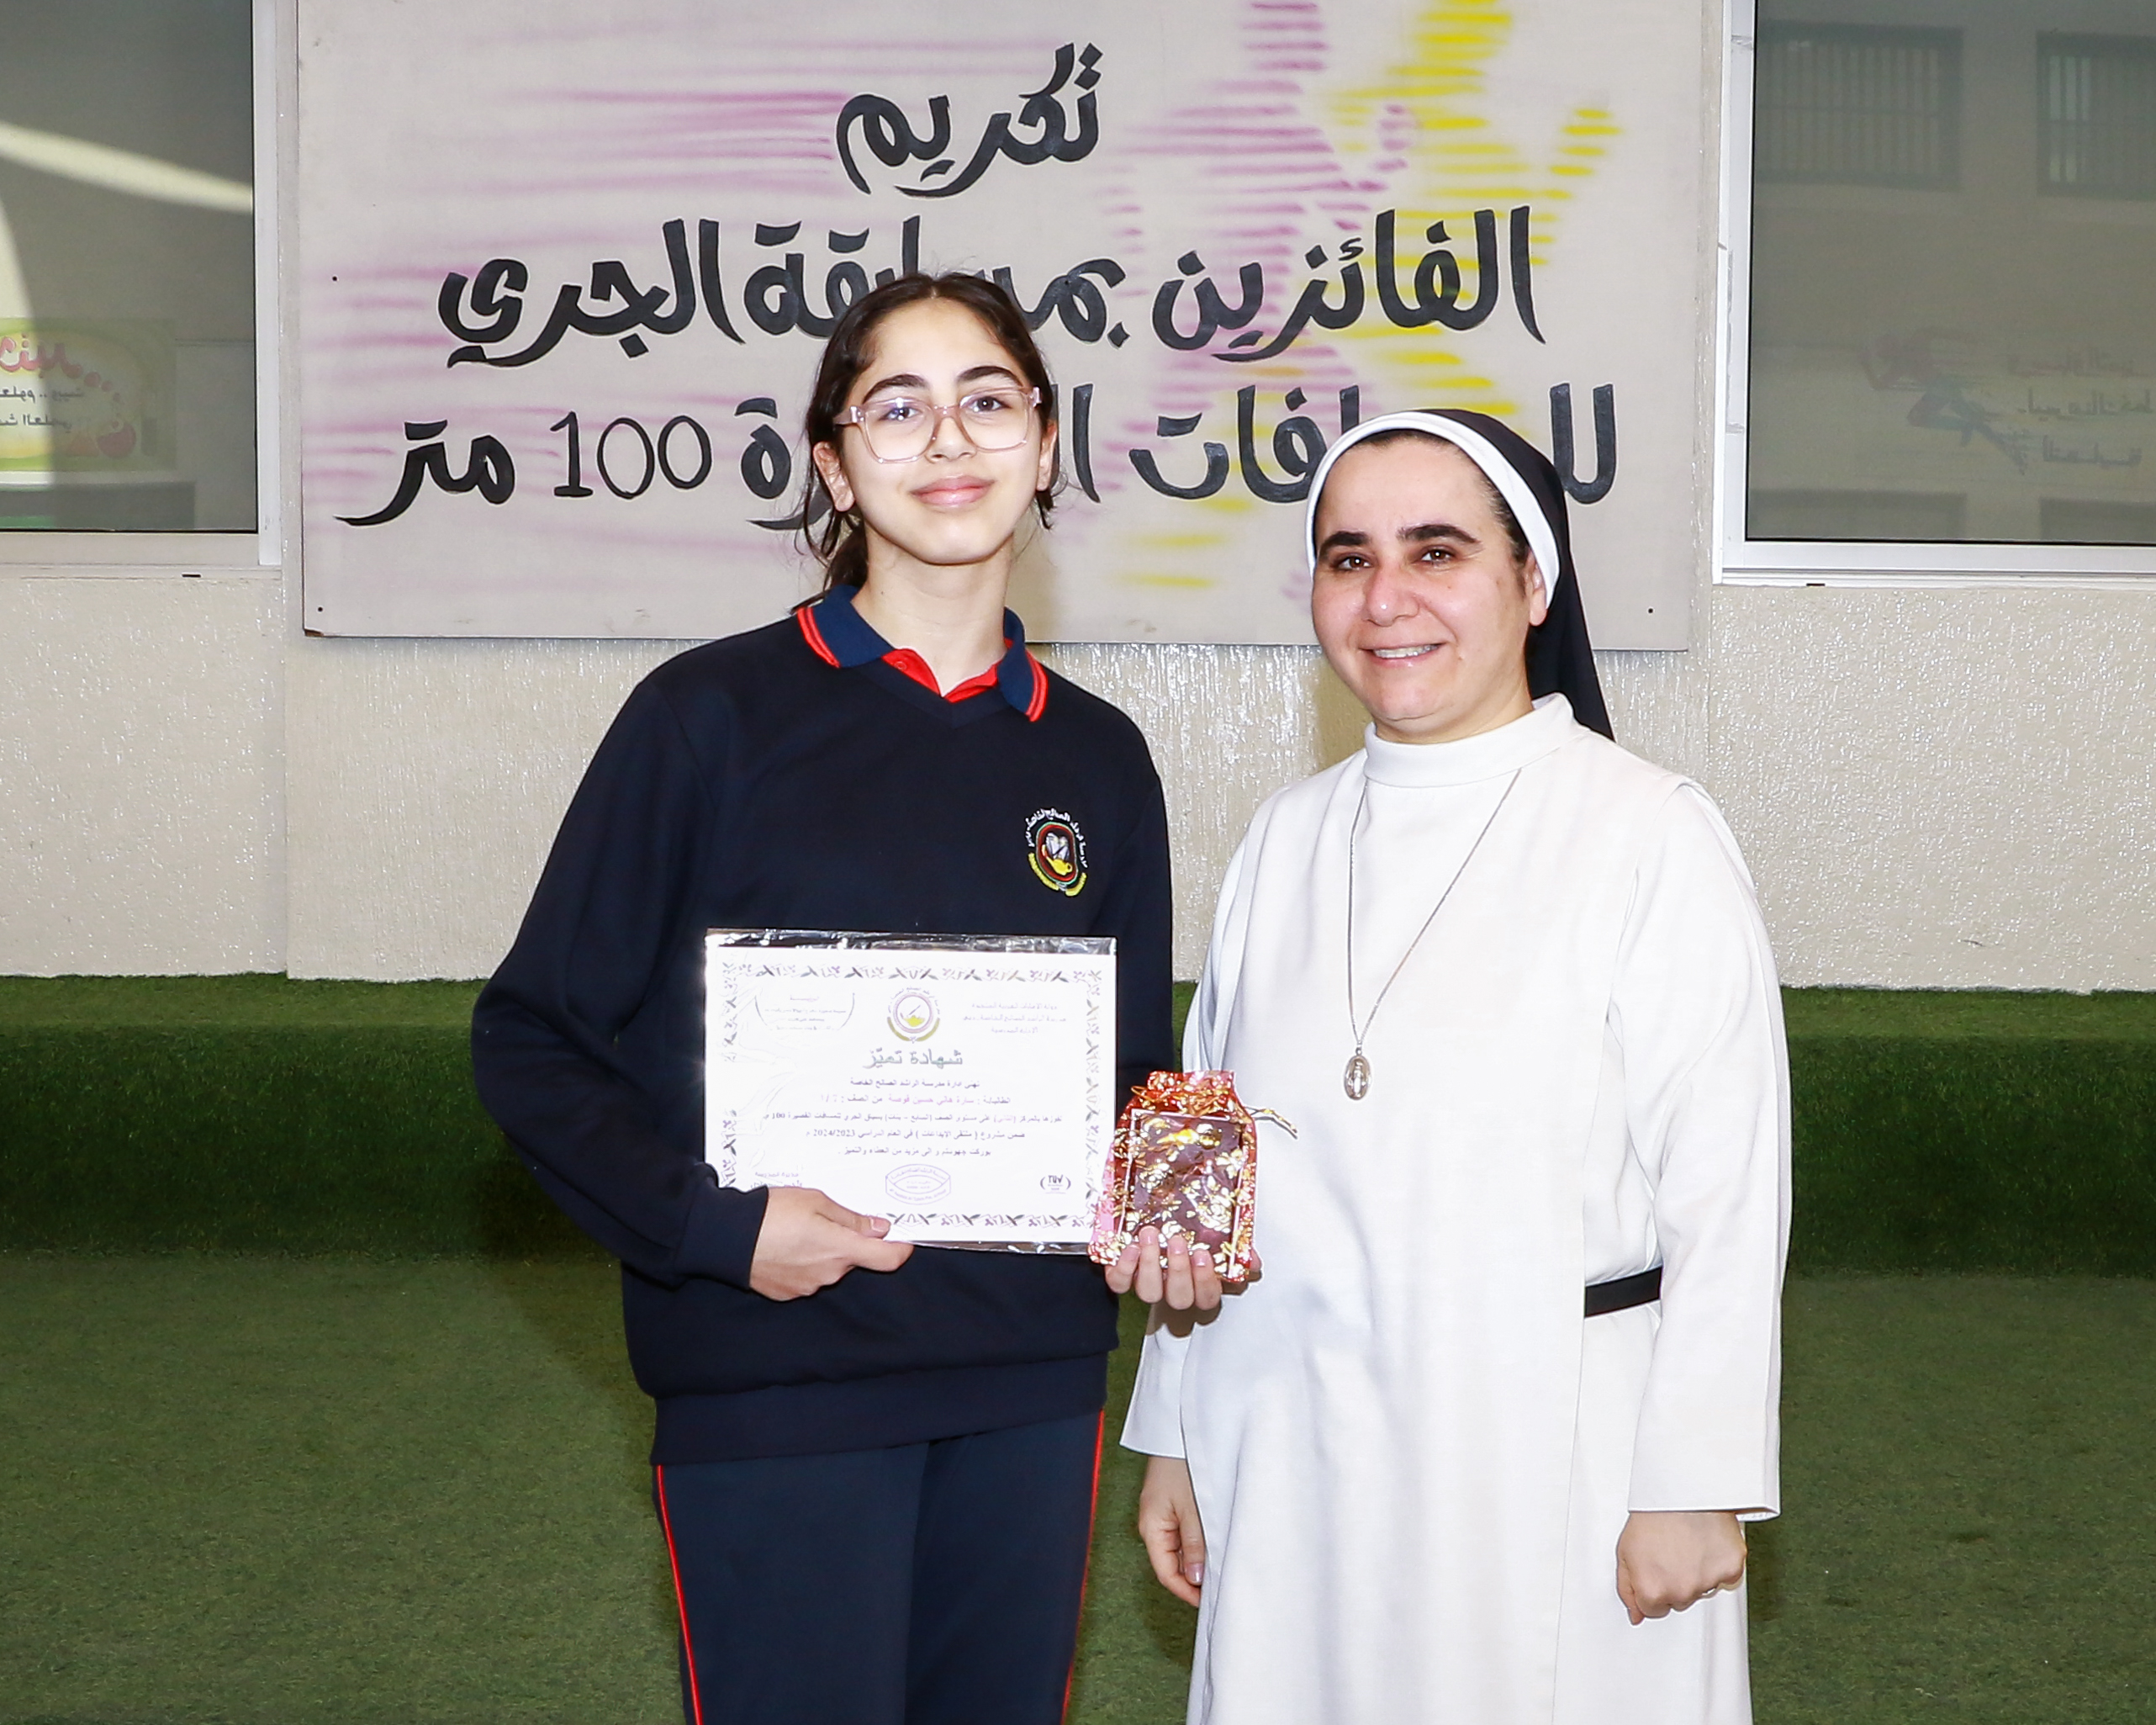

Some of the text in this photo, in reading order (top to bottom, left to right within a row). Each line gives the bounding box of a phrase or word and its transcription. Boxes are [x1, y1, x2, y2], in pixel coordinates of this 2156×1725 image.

[835, 43, 1103, 198] تكريم
[437, 218, 746, 368] الجري
[1150, 205, 1546, 362] الفائزين
[548, 410, 713, 500] 100
[333, 419, 515, 527] متر
[909, 1048, 963, 1070] شهادة
[850, 1077, 873, 1086] الخاصة
[875, 1079, 897, 1088] الصالح
[922, 1079, 945, 1088] مدرسة
[872, 1096, 883, 1104] من
[980, 1130, 1005, 1140] مشروع
